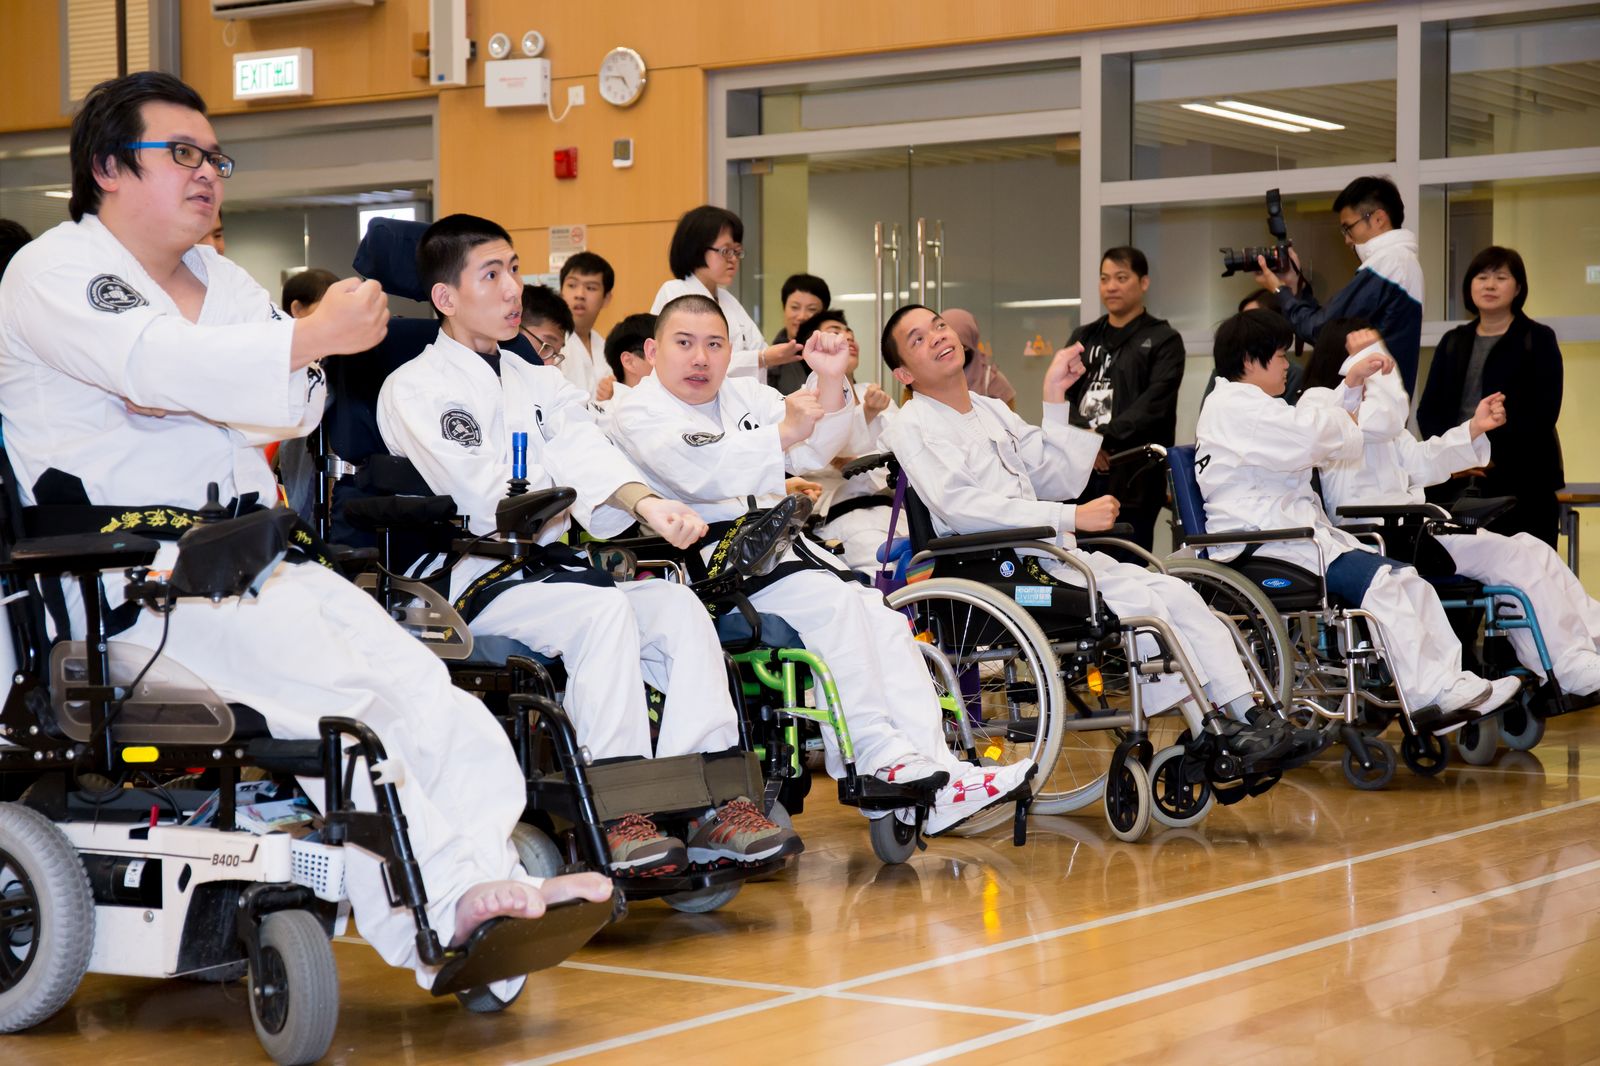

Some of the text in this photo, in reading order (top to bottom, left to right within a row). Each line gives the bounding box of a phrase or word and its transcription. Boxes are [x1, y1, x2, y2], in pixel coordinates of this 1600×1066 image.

[240, 60, 294, 91] EXIT 出口
[211, 853, 240, 867] B400
